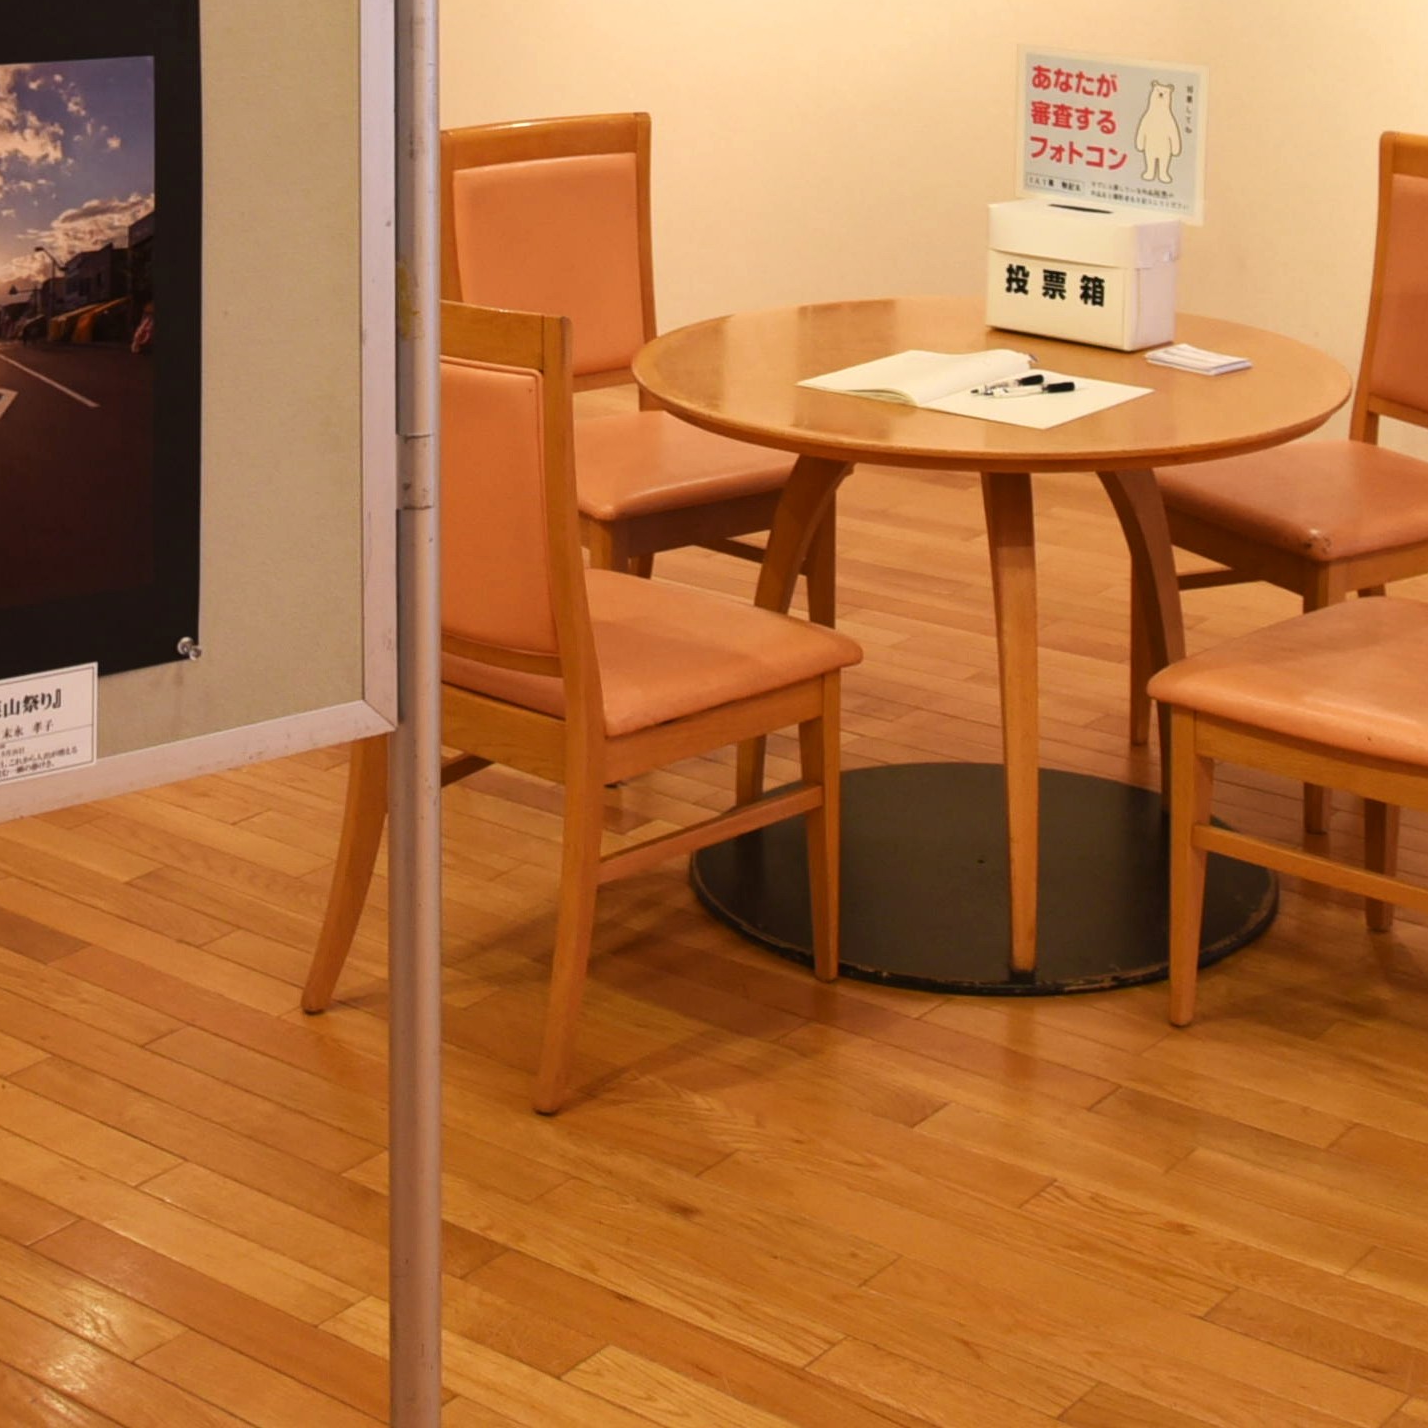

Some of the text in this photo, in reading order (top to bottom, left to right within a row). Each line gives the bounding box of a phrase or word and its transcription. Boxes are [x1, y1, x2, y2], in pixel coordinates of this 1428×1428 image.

[1031, 65, 1118, 99] あなたが
[1030, 100, 1117, 136] 審査する
[1029, 136, 1128, 171] フォトコン
[1005, 263, 1106, 308] 投票箱
